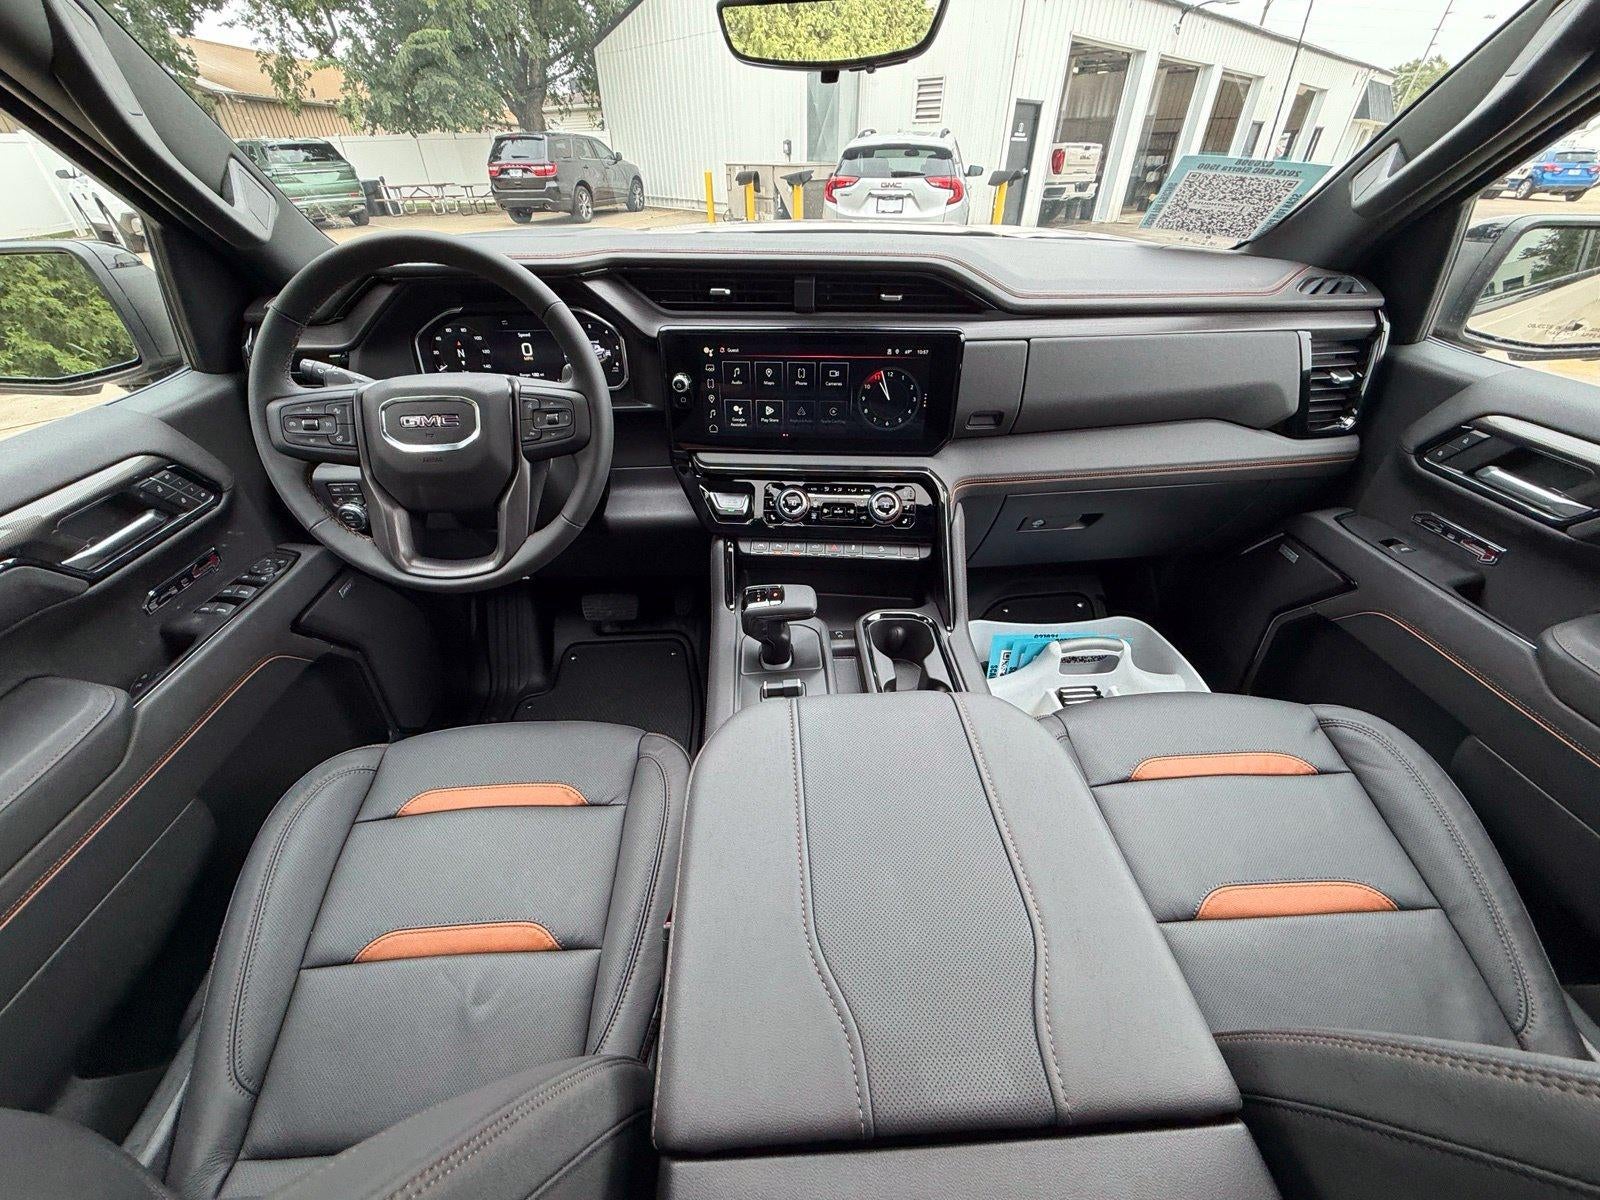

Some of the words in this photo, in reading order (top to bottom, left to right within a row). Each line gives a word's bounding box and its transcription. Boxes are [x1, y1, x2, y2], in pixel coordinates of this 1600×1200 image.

[457, 349, 465, 358] N
[521, 342, 533, 356] 0
[400, 414, 460, 428] GMC
